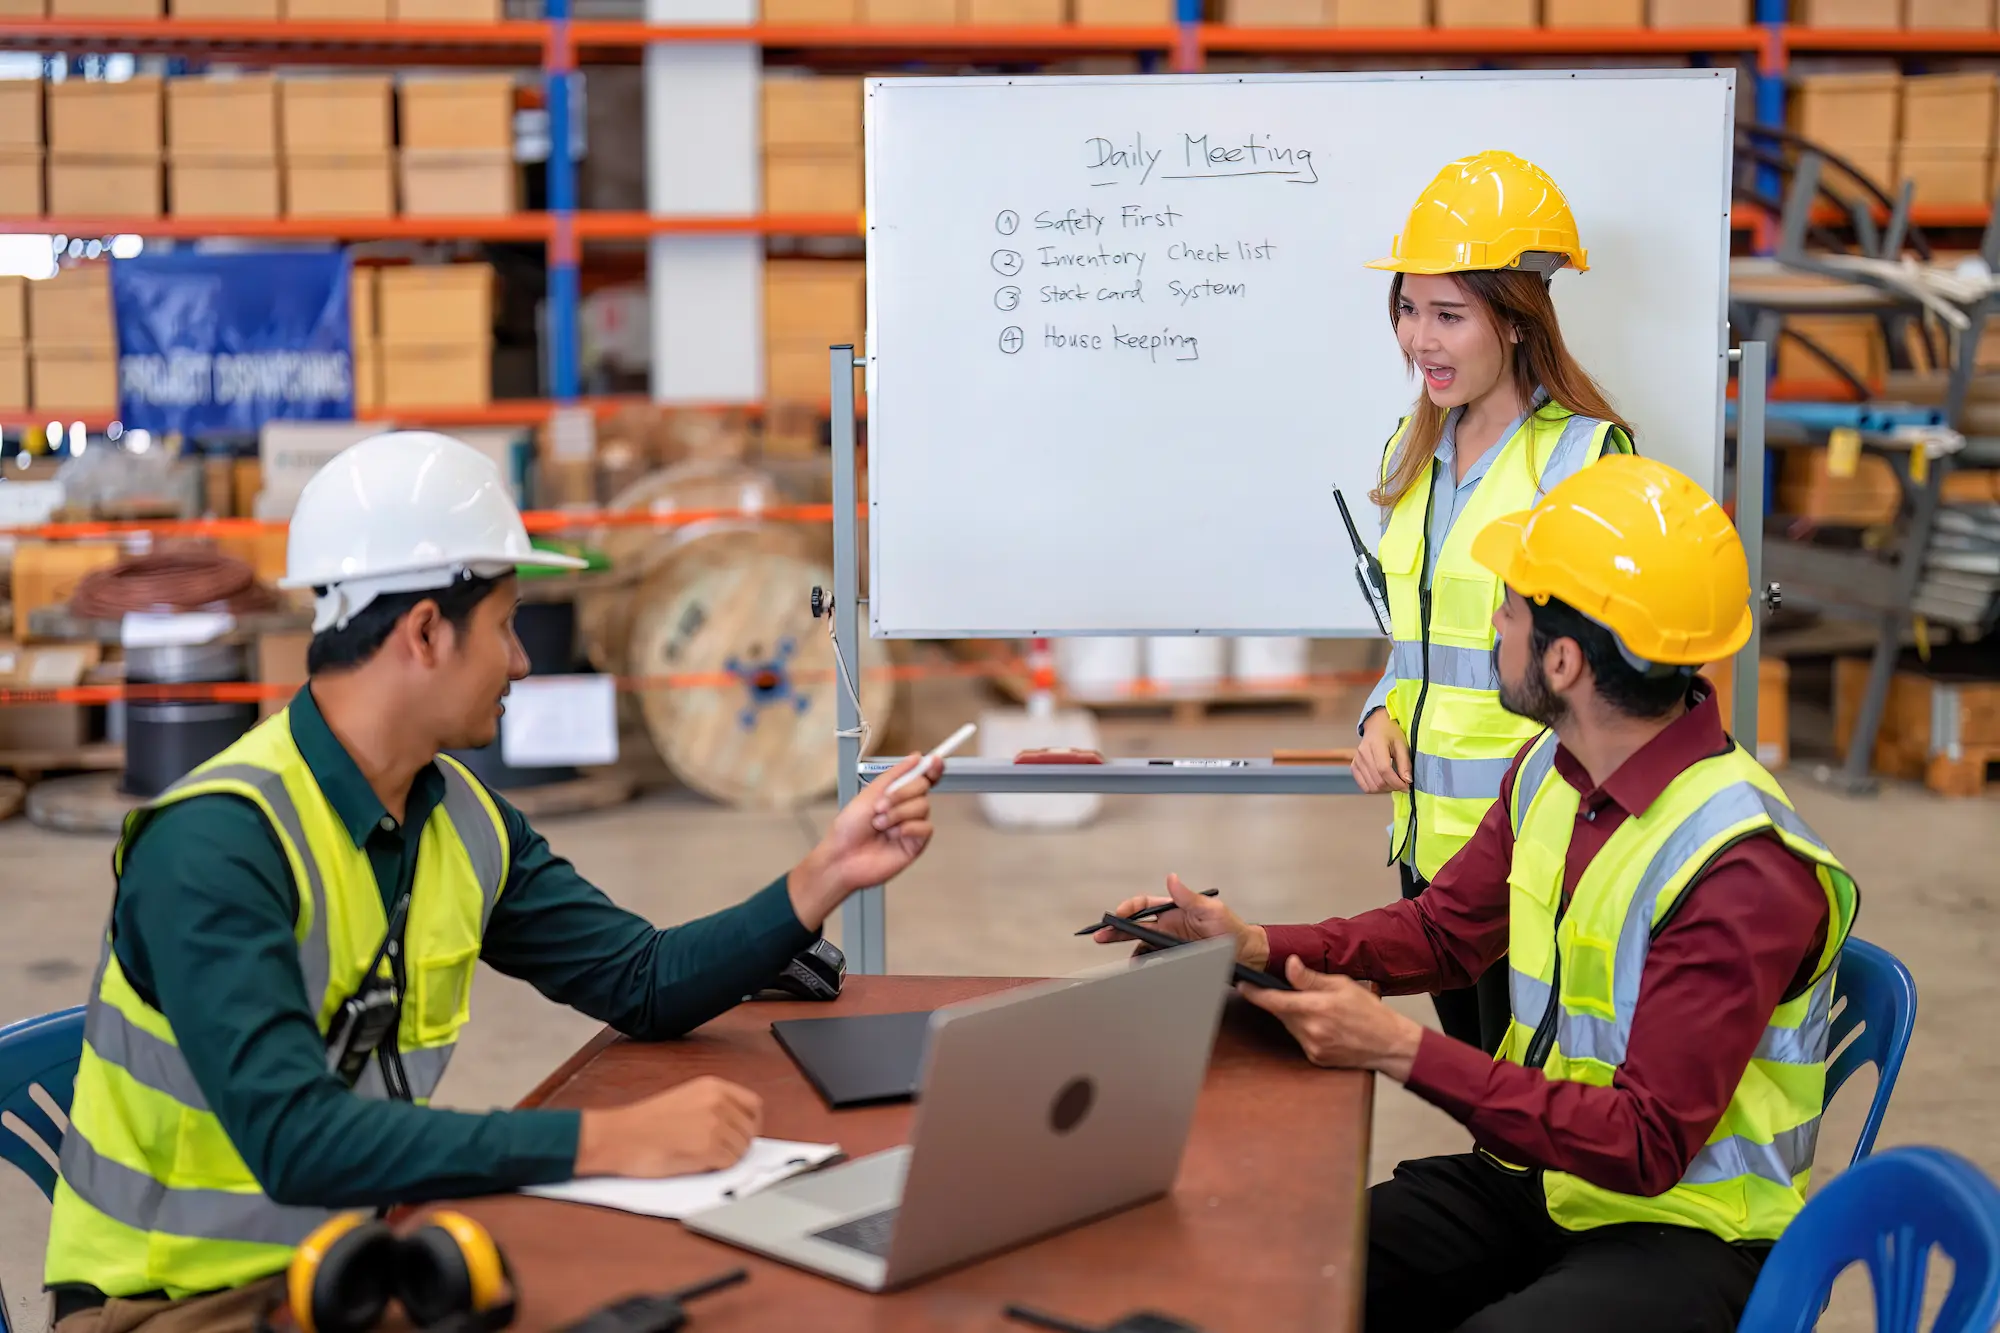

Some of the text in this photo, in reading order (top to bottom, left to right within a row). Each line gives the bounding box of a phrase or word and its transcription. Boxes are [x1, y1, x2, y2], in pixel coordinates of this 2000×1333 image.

[1085, 132, 1319, 185] Daily Meeting
[1033, 207, 1105, 236] Safety
[1121, 204, 1183, 229] First
[1036, 243, 1147, 276] Inventory
[1168, 278, 1246, 308] System
[1045, 322, 1102, 351] House
